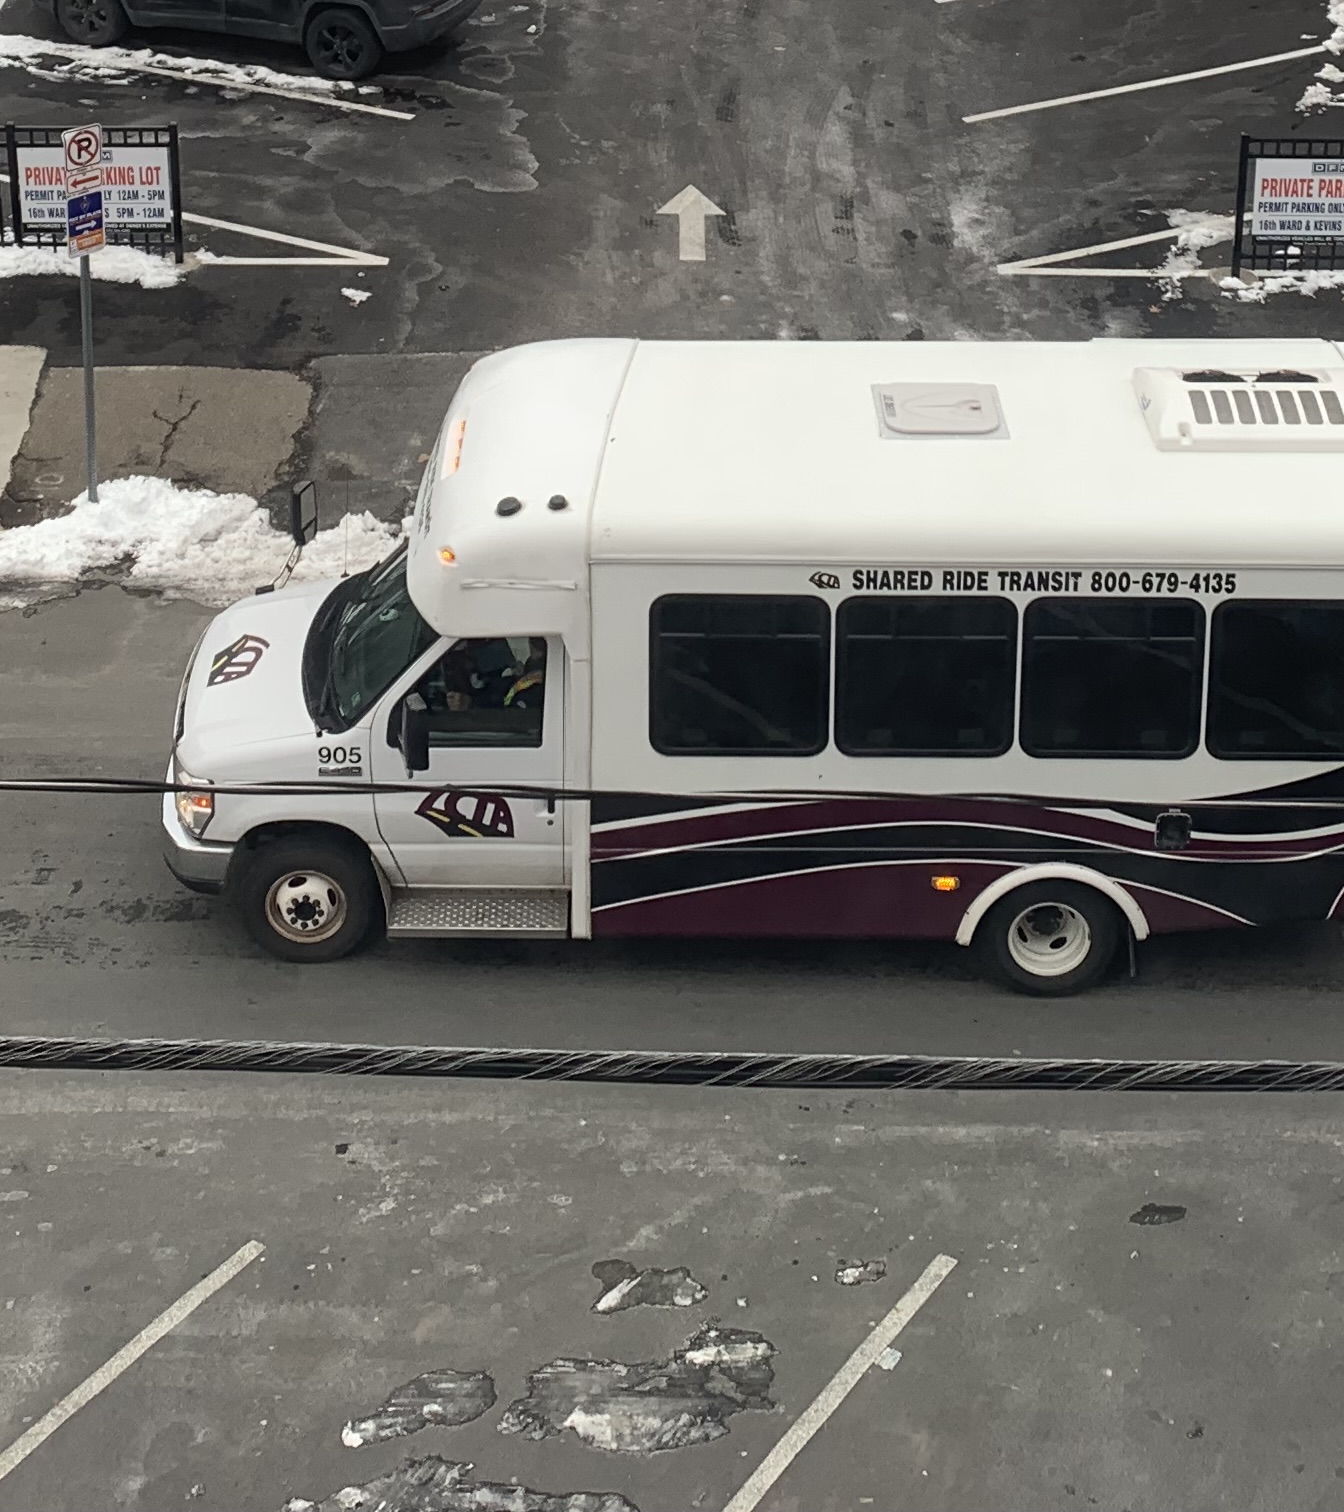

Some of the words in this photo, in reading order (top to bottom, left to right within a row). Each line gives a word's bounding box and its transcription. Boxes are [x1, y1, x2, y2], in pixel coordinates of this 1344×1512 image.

[25, 166, 67, 186] PRIVA
[139, 166, 161, 185] LOT
[1261, 178, 1314, 198] PRIVATE
[25, 190, 54, 201] PERMIT
[117, 190, 139, 200] 12AM
[148, 190, 165, 200] 5PM
[28, 208, 45, 218] 16th
[48, 208, 66, 218] WAR
[117, 208, 134, 218] 5PM
[143, 208, 165, 218] 12AM
[1258, 202, 1289, 213] PERMIT
[1291, 202, 1325, 214] PARKING
[1259, 220, 1276, 231] 16th
[1279, 220, 1302, 231] WARD
[1305, 221, 1311, 231] &
[1314, 220, 1342, 231] KEVINS
[852, 569, 933, 591] SHARED
[941, 571, 988, 592] RIDE
[997, 571, 1082, 592] TRANSIT
[1090, 572, 1237, 594] 800-679-4135
[318, 746, 362, 764] 905
